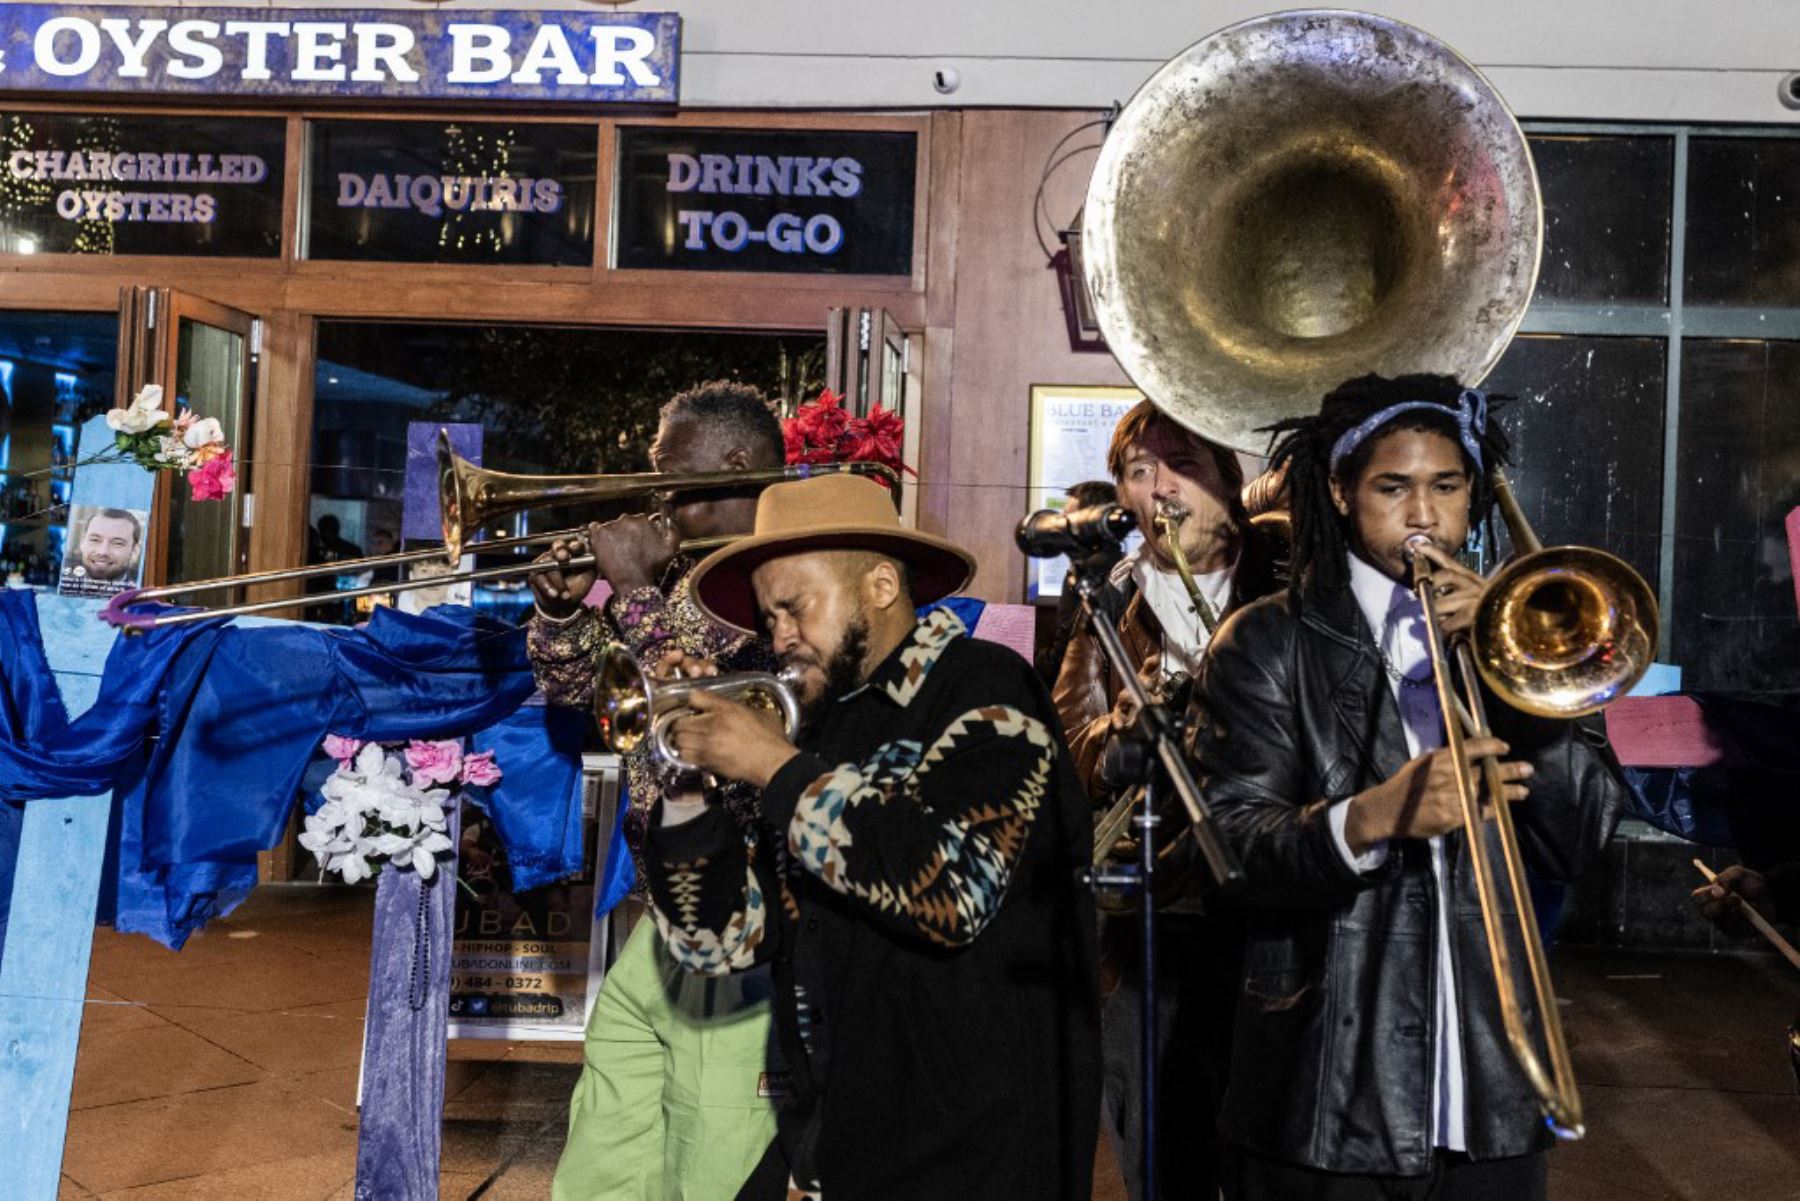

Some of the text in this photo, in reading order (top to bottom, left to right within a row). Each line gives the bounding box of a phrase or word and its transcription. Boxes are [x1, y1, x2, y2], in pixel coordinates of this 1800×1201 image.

[34, 17, 660, 86] OYSTER BAR
[9, 150, 267, 184] CHARGRILLED
[666, 153, 863, 197] DRINKS
[56, 190, 218, 222] OYSTERS
[337, 173, 564, 217] DAIQUIRIS
[678, 210, 844, 253] TO-GO
[522, 944, 557, 954] SOUL
[505, 977, 542, 989] 0372
